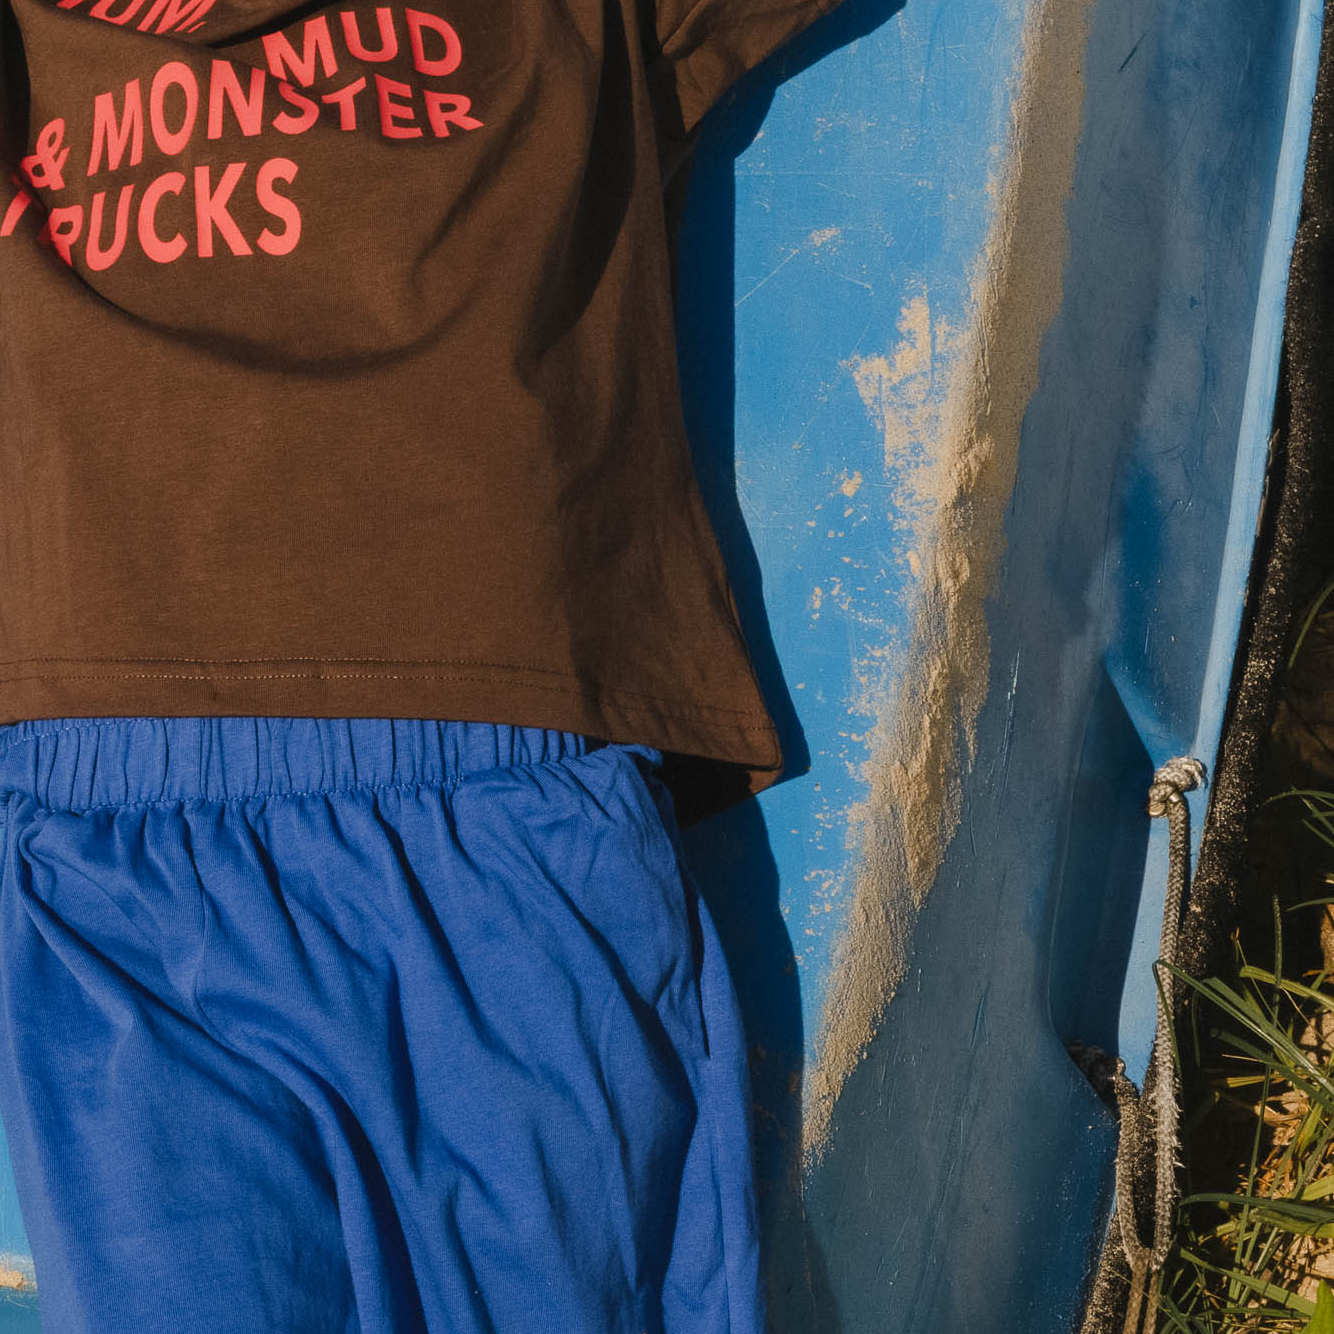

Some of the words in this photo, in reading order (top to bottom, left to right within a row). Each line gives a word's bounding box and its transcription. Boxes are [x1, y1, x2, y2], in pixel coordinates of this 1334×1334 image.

[262, 7, 463, 88] MUD
[20, 117, 70, 190] &
[86, 59, 485, 177] MONSTER
